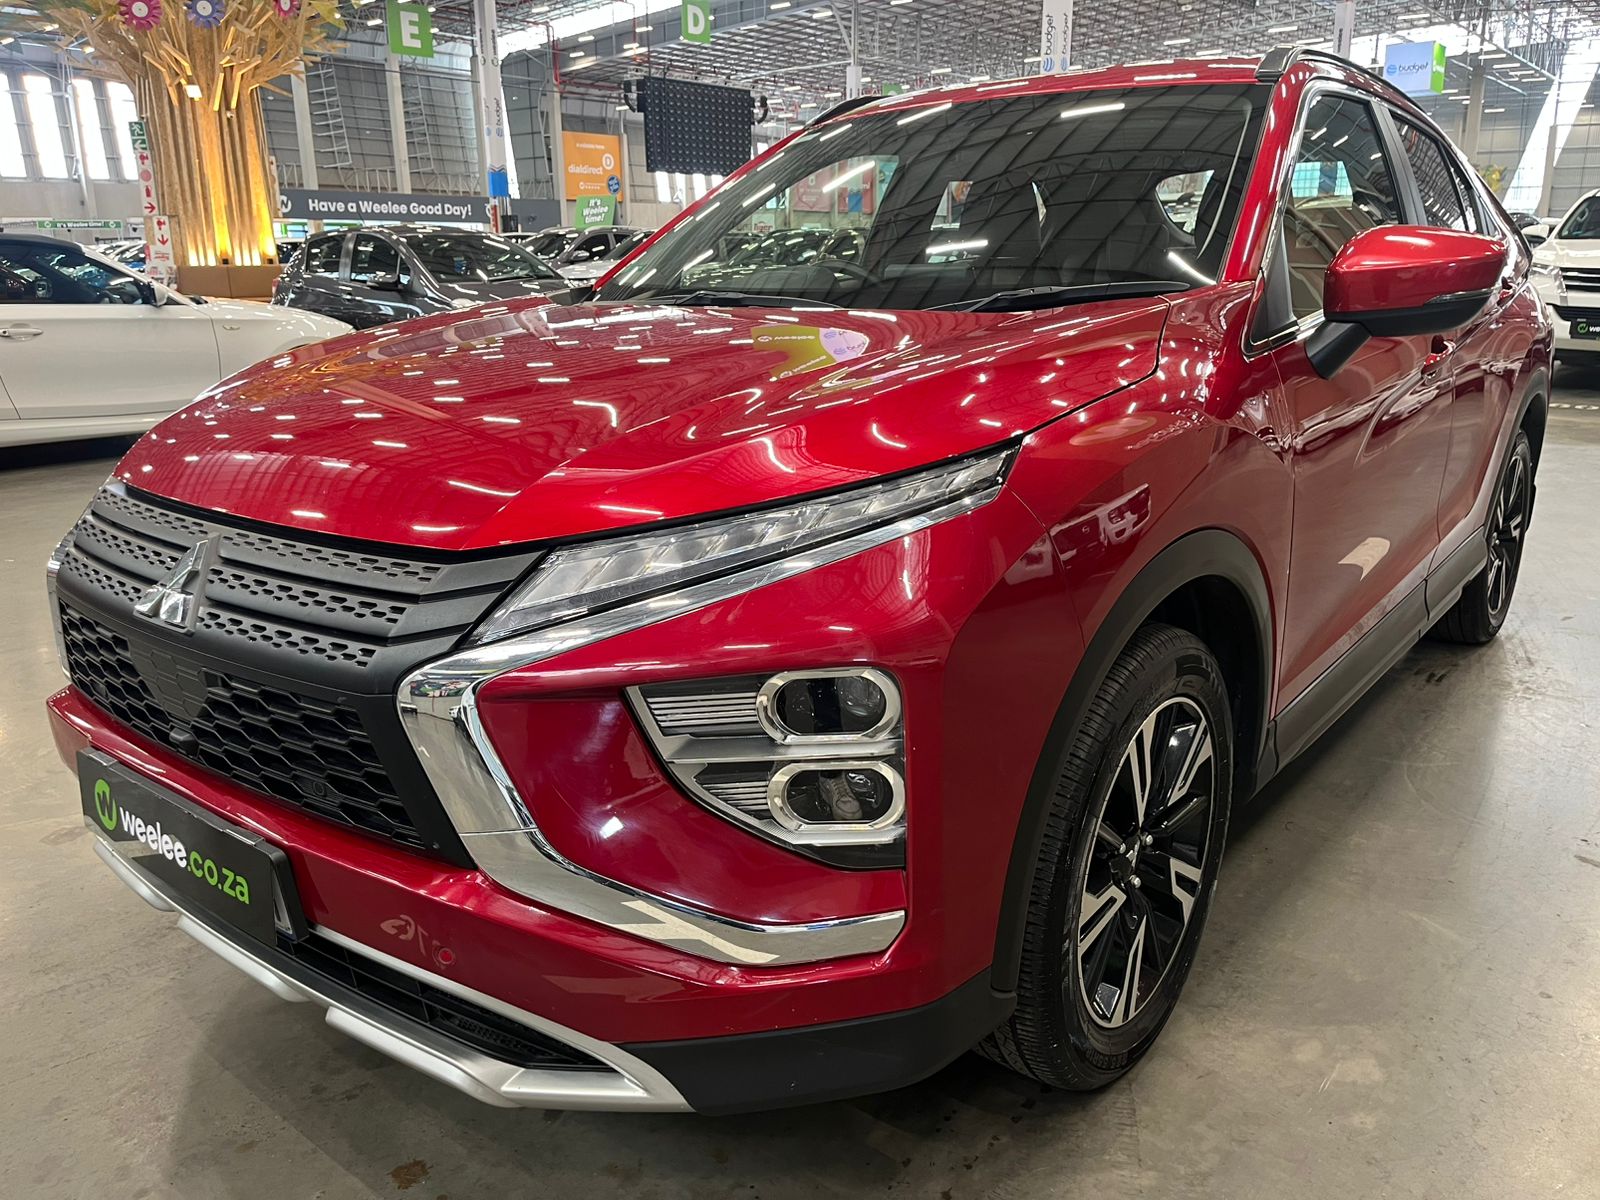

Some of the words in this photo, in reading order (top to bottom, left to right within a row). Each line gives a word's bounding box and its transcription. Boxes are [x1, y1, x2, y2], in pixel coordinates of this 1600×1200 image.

[400, 10, 422, 48] E
[687, 4, 705, 35] D
[1044, 14, 1056, 56] budget
[1398, 62, 1429, 73] budget
[568, 164, 603, 175] dialdirect
[308, 199, 345, 213] Have
[347, 202, 358, 213] a
[359, 201, 408, 215] Weelee
[409, 203, 443, 215] Good
[444, 204, 473, 219] Day!
[119, 806, 250, 905] weelee.co.za
